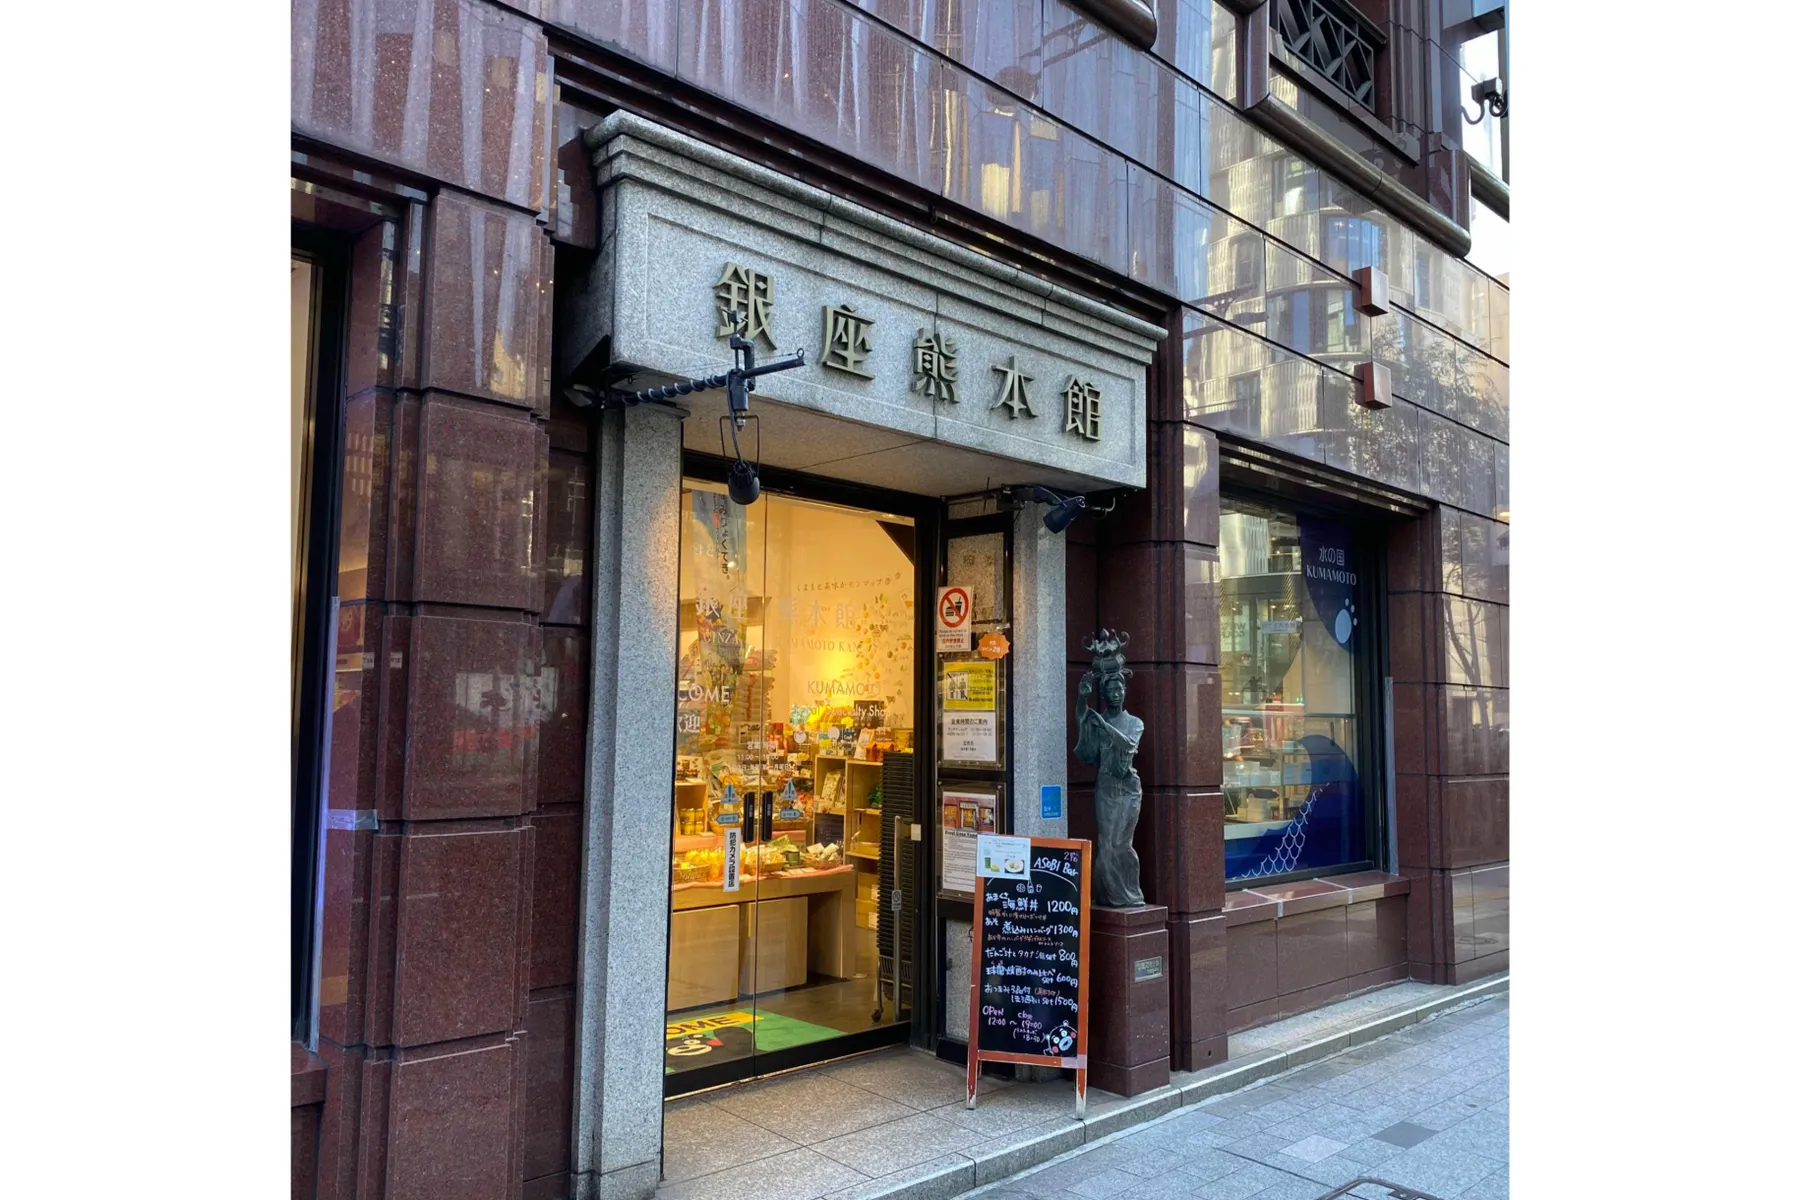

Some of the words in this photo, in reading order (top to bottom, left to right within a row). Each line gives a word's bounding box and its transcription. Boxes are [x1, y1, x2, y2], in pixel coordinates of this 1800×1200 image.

[713, 261, 1103, 442] 銀座熊本館
[1319, 545, 1345, 566] 水の国
[1306, 564, 1357, 586] KUMAMOTO
[1062, 862, 1079, 876] Bar
[1047, 900, 1079, 915] 1200円
[1054, 924, 1079, 938] 1300円
[1058, 949, 1078, 968] 800円
[1056, 973, 1078, 987] 600円
[1055, 995, 1078, 1013] 1500円
[988, 1017, 1006, 1026] 12:00
[1021, 1020, 1042, 1030] 19:00
